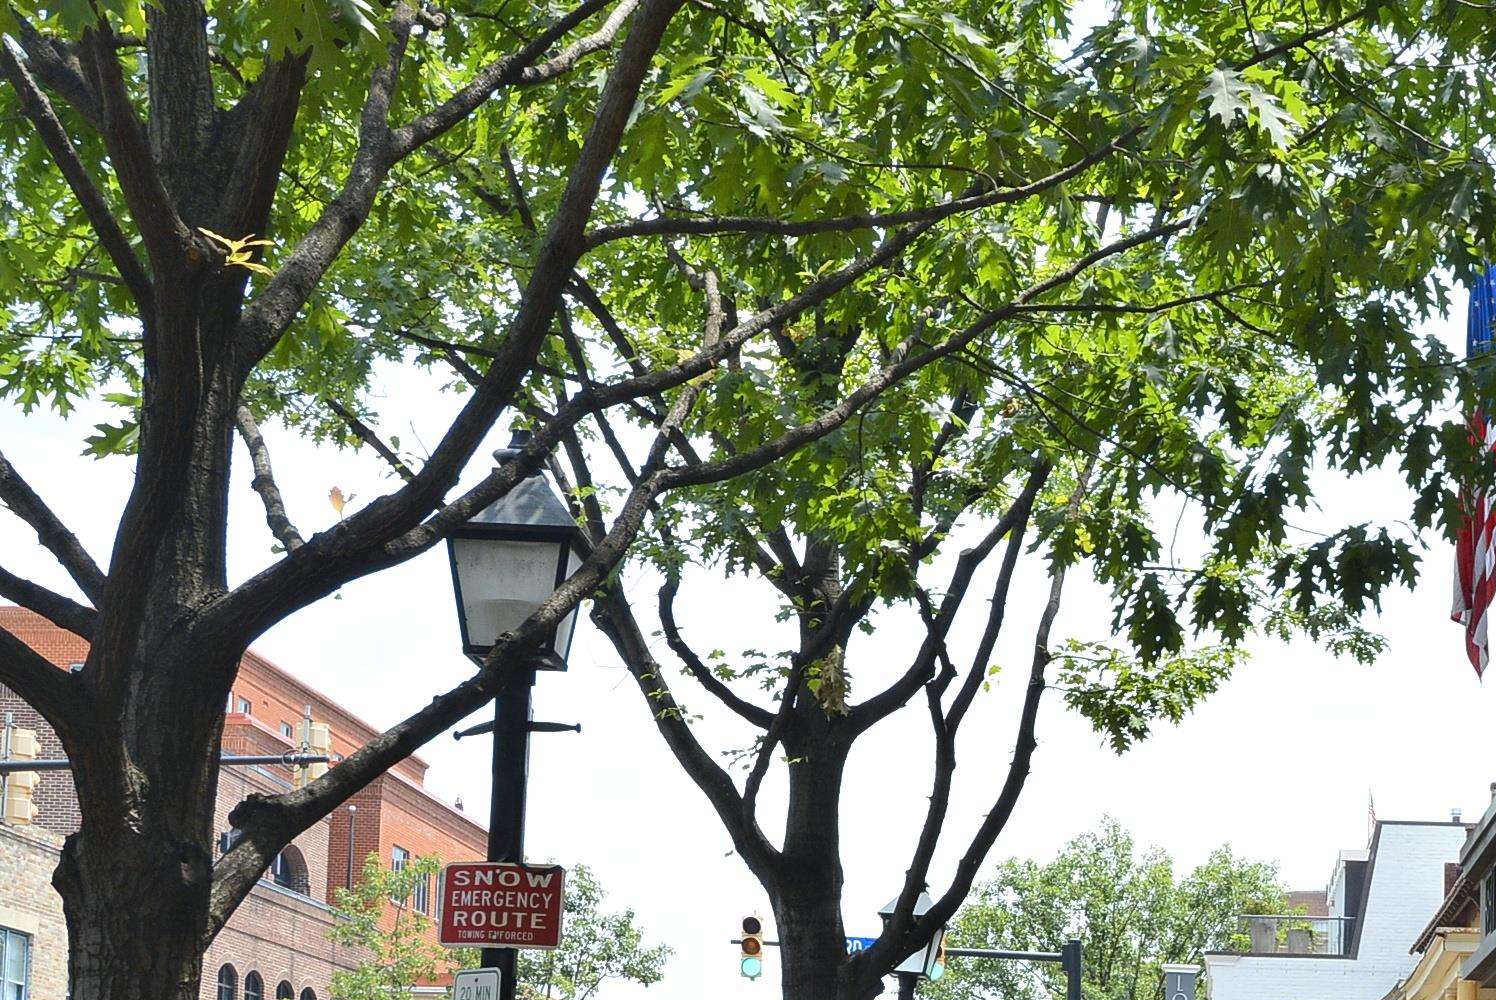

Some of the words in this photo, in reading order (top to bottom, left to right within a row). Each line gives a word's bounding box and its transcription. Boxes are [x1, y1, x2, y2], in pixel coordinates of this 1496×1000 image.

[453, 869, 553, 889] SNOW
[451, 890, 553, 909] EMERGENCY
[452, 910, 547, 930] ROUTE
[457, 930, 485, 939] TOWING
[475, 985, 491, 1000] MIN
